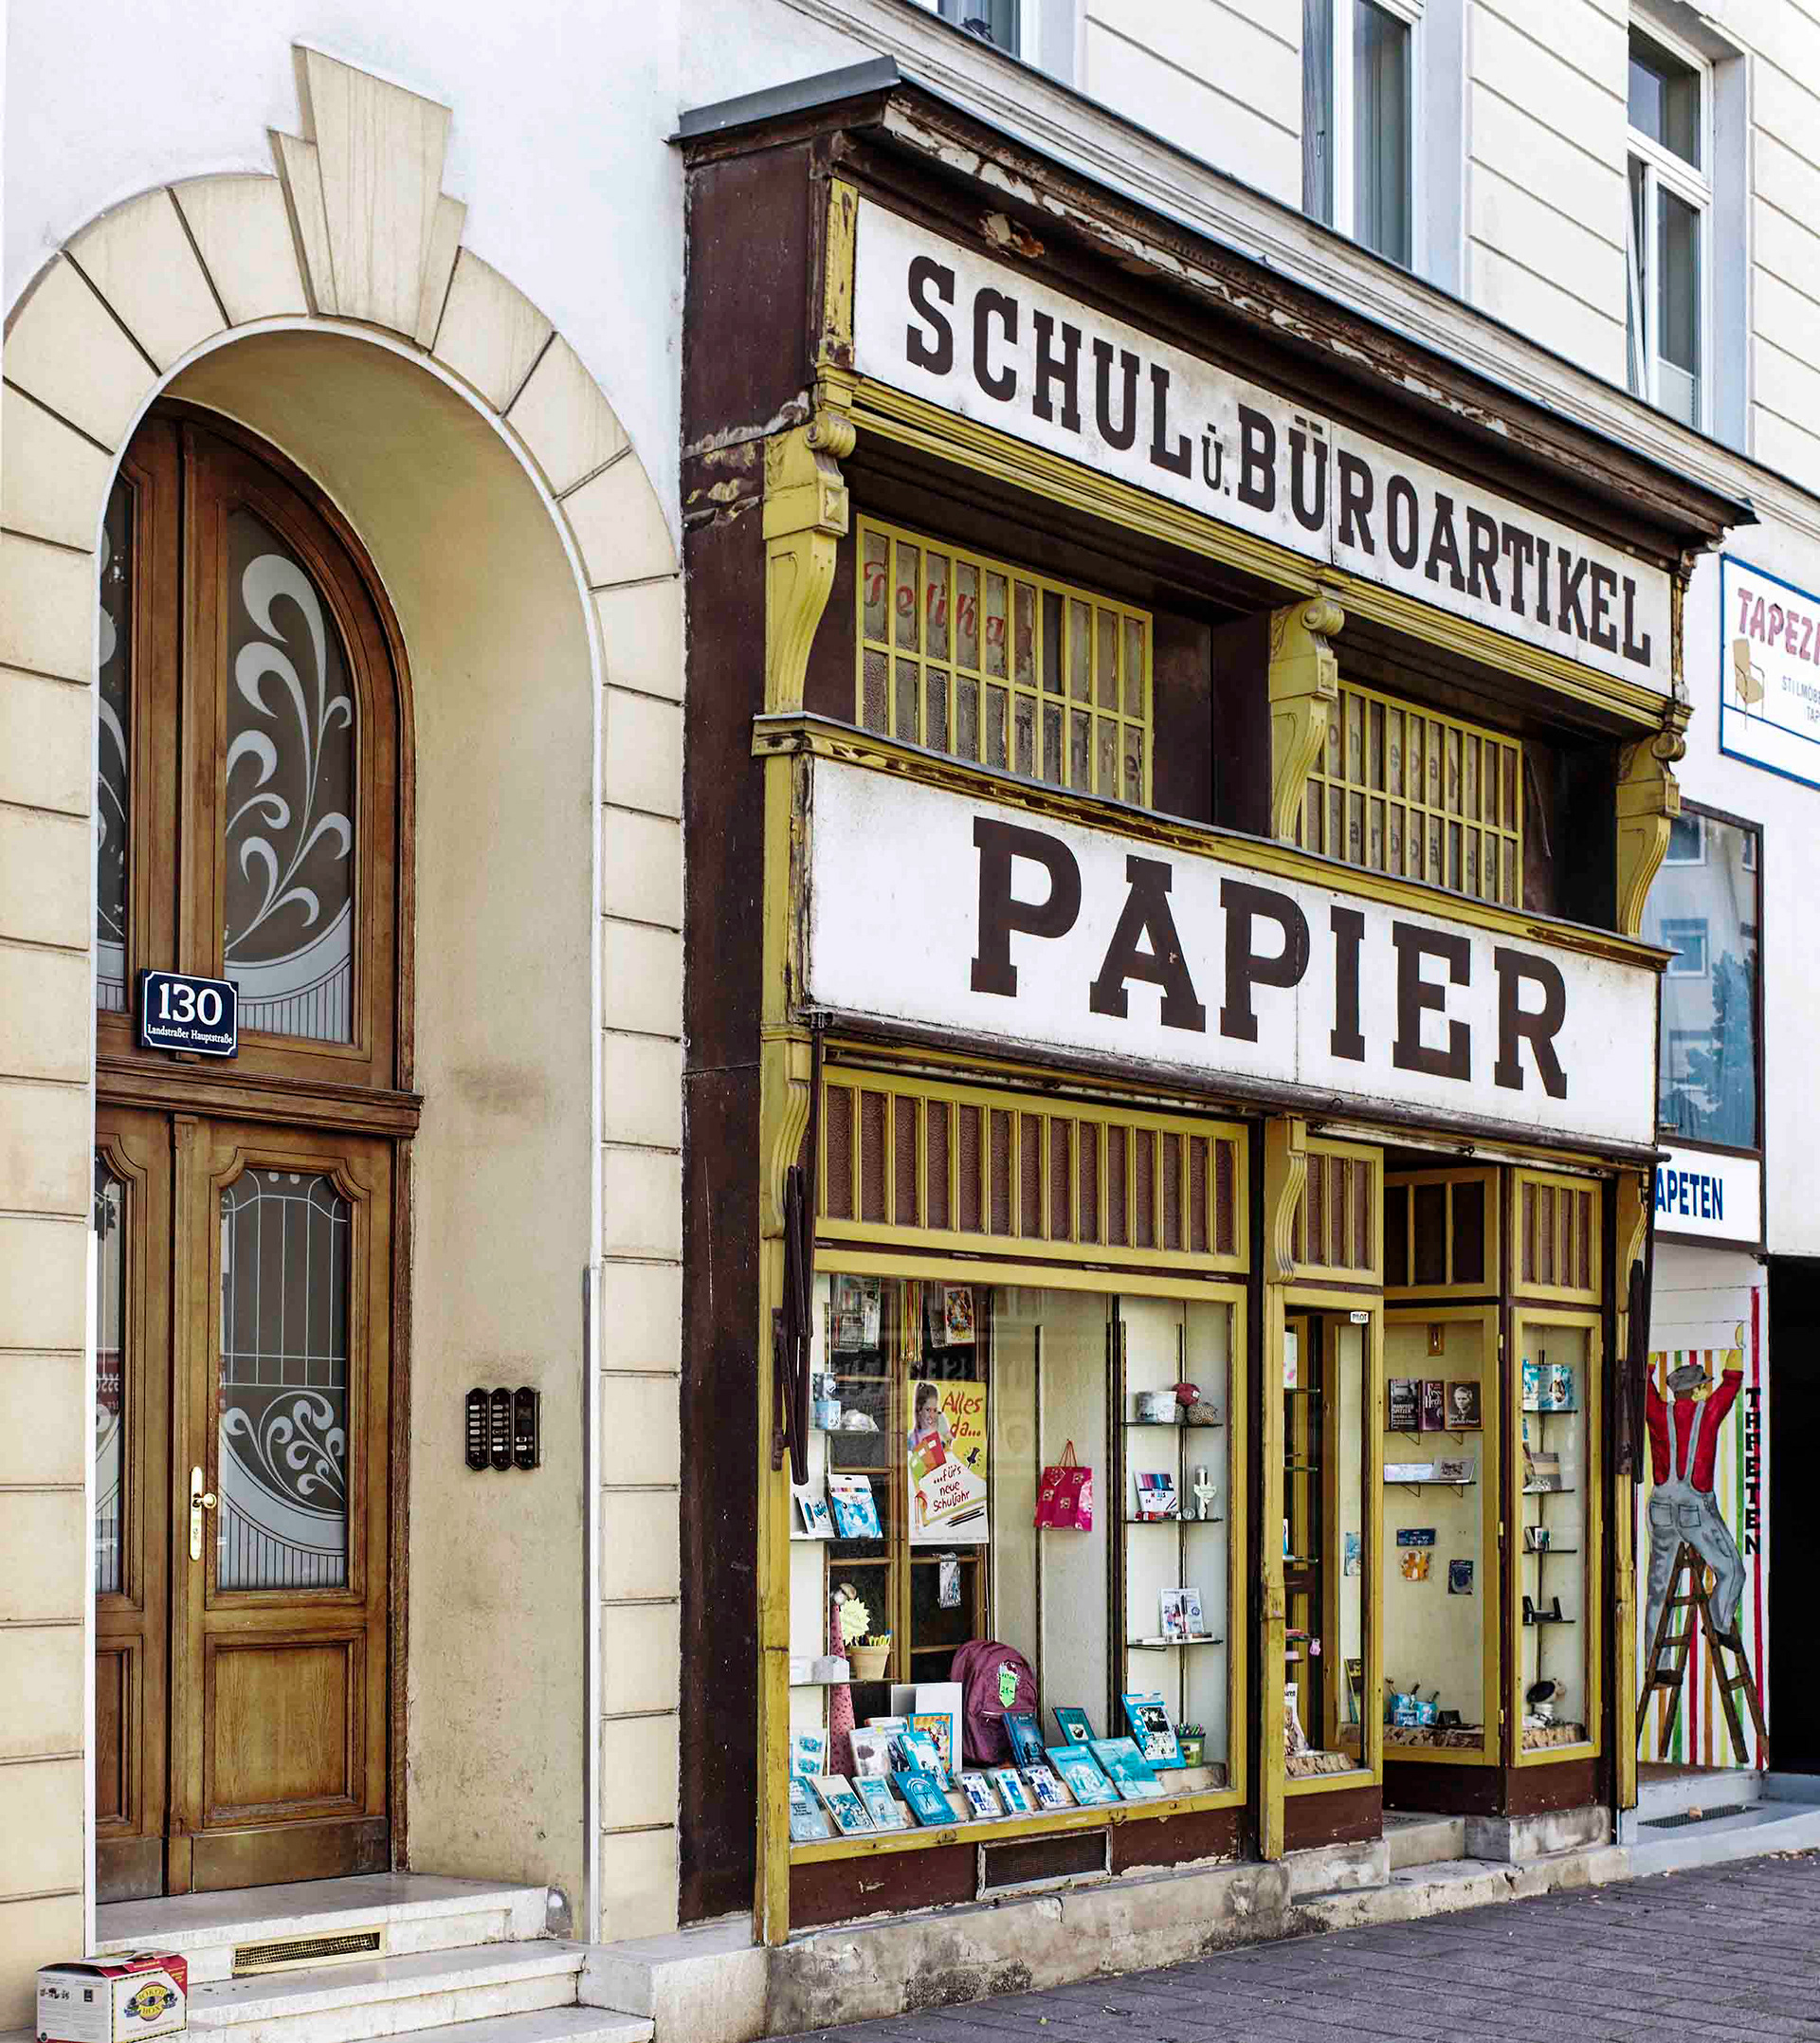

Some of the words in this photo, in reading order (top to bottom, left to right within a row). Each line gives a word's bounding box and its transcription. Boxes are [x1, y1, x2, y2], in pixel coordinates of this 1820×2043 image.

[907, 256, 1192, 479] SCHUL
[1238, 404, 1650, 667] BÜROARTIKEL
[970, 816, 1567, 1100] PAPIER
[158, 982, 223, 1026] 130
[147, 1024, 190, 1039] Landstraßer
[191, 1030, 233, 1044] Hauptstraße
[1655, 1168, 1723, 1221] APETEN
[941, 1390, 983, 1415] Alles
[933, 1490, 971, 1513] Schuljahr
[939, 1481, 960, 1496] neue
